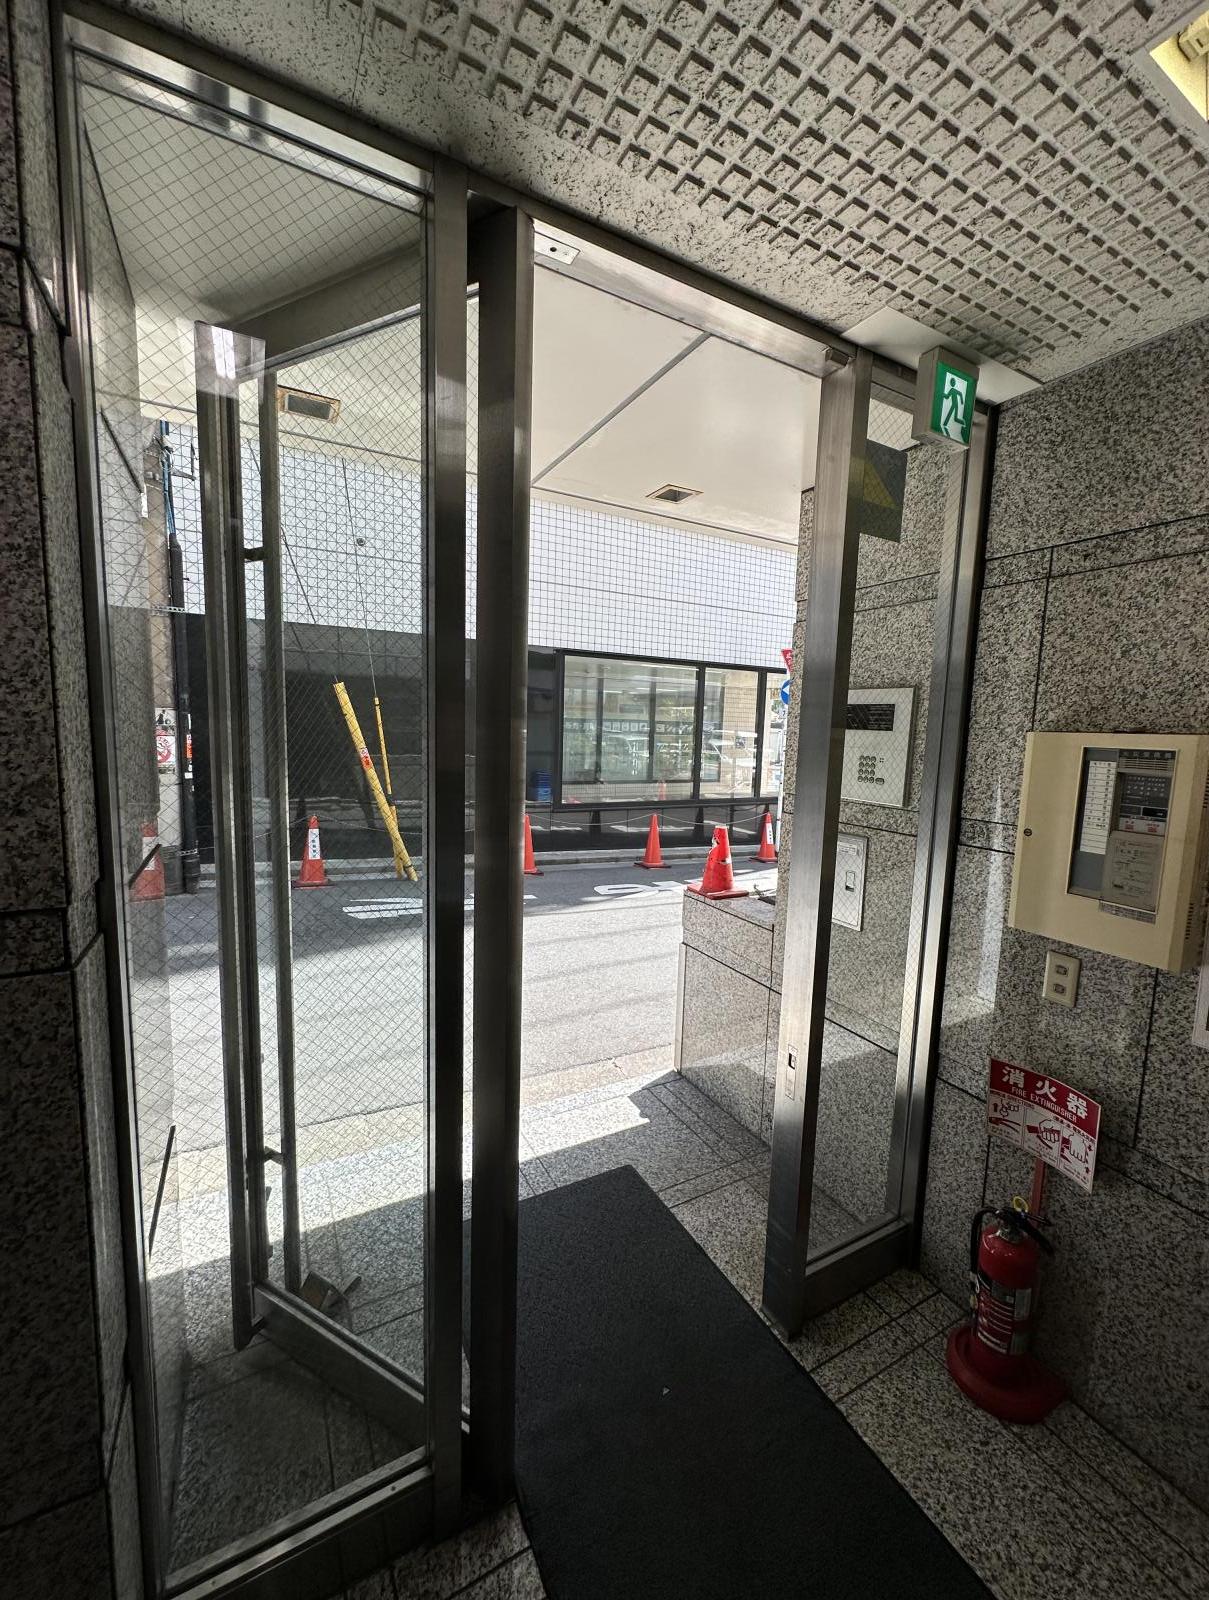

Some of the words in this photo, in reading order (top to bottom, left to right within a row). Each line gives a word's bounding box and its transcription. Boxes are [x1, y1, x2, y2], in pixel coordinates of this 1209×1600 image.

[1002, 1066, 1088, 1119] 消火器
[1011, 1086, 1027, 1098] FIRE
[1030, 1093, 1077, 1122] EXTINGUISHER
